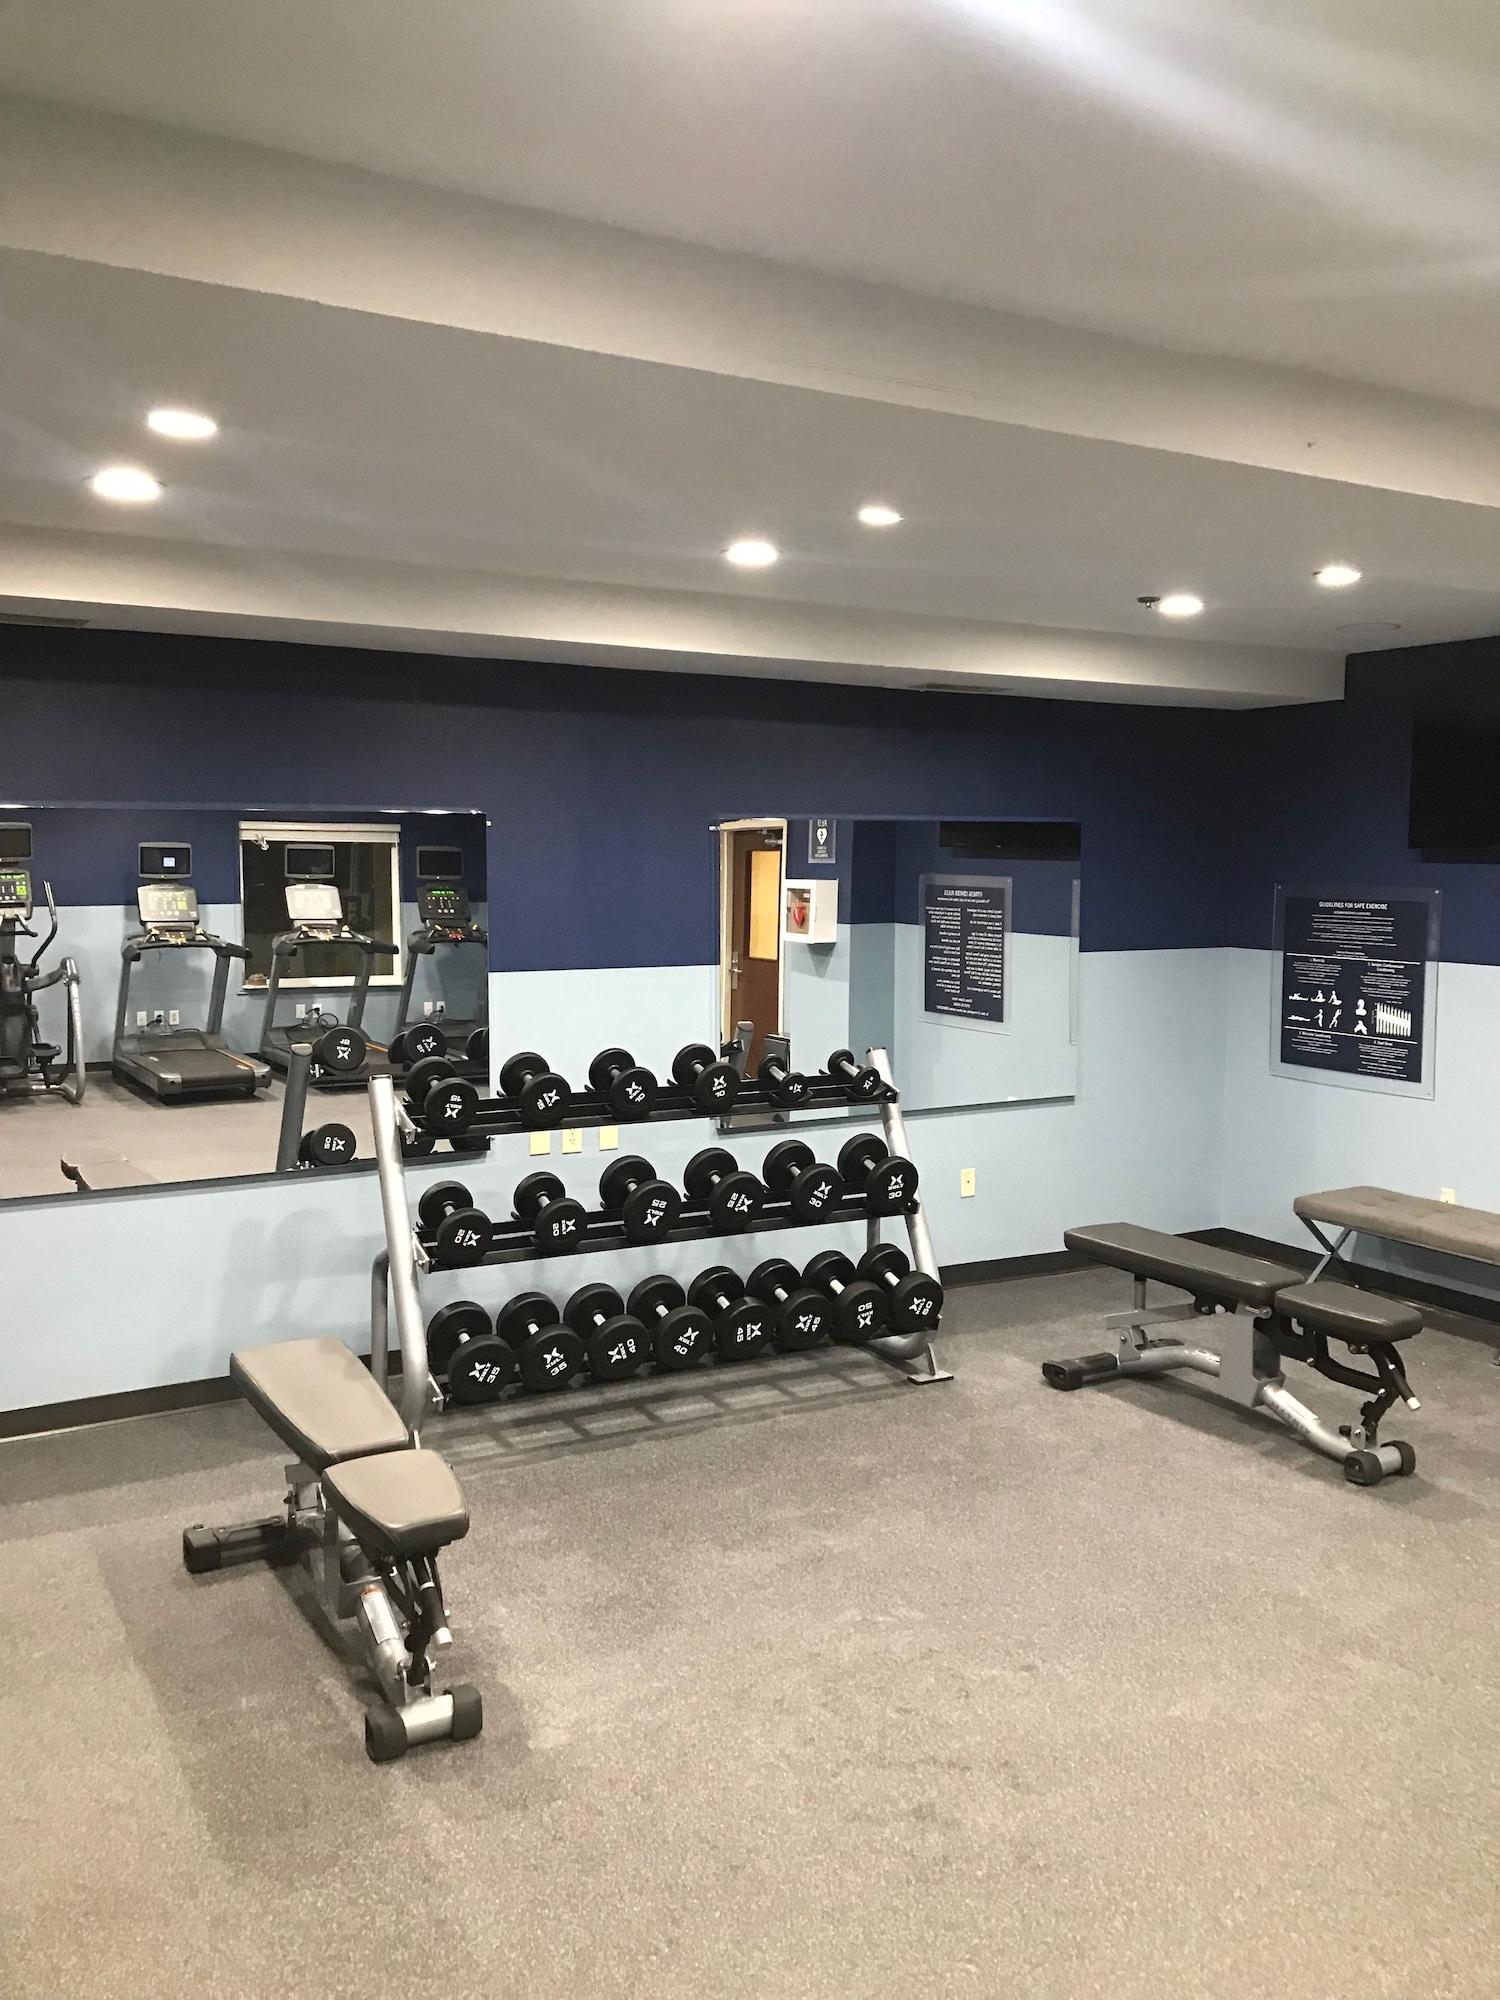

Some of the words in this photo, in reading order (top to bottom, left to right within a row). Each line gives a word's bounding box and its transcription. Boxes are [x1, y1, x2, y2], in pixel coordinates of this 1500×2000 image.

[635, 1093, 645, 1102] 10
[715, 1090, 726, 1098] 10
[888, 1183, 904, 1191] XULT
[727, 1192, 739, 1208] 25
[888, 1191, 902, 1200] 30
[651, 1199, 667, 1208] 25
[809, 1197, 822, 1208] 30
[552, 1223, 559, 1236] 20
[455, 1229, 465, 1244] 20
[858, 1302, 872, 1312] 50
[737, 1327, 744, 1342] 45
[627, 1338, 636, 1353] 40
[673, 1344, 688, 1355] 40
[550, 1361, 567, 1376] 35
[487, 1366, 501, 1383] 35
